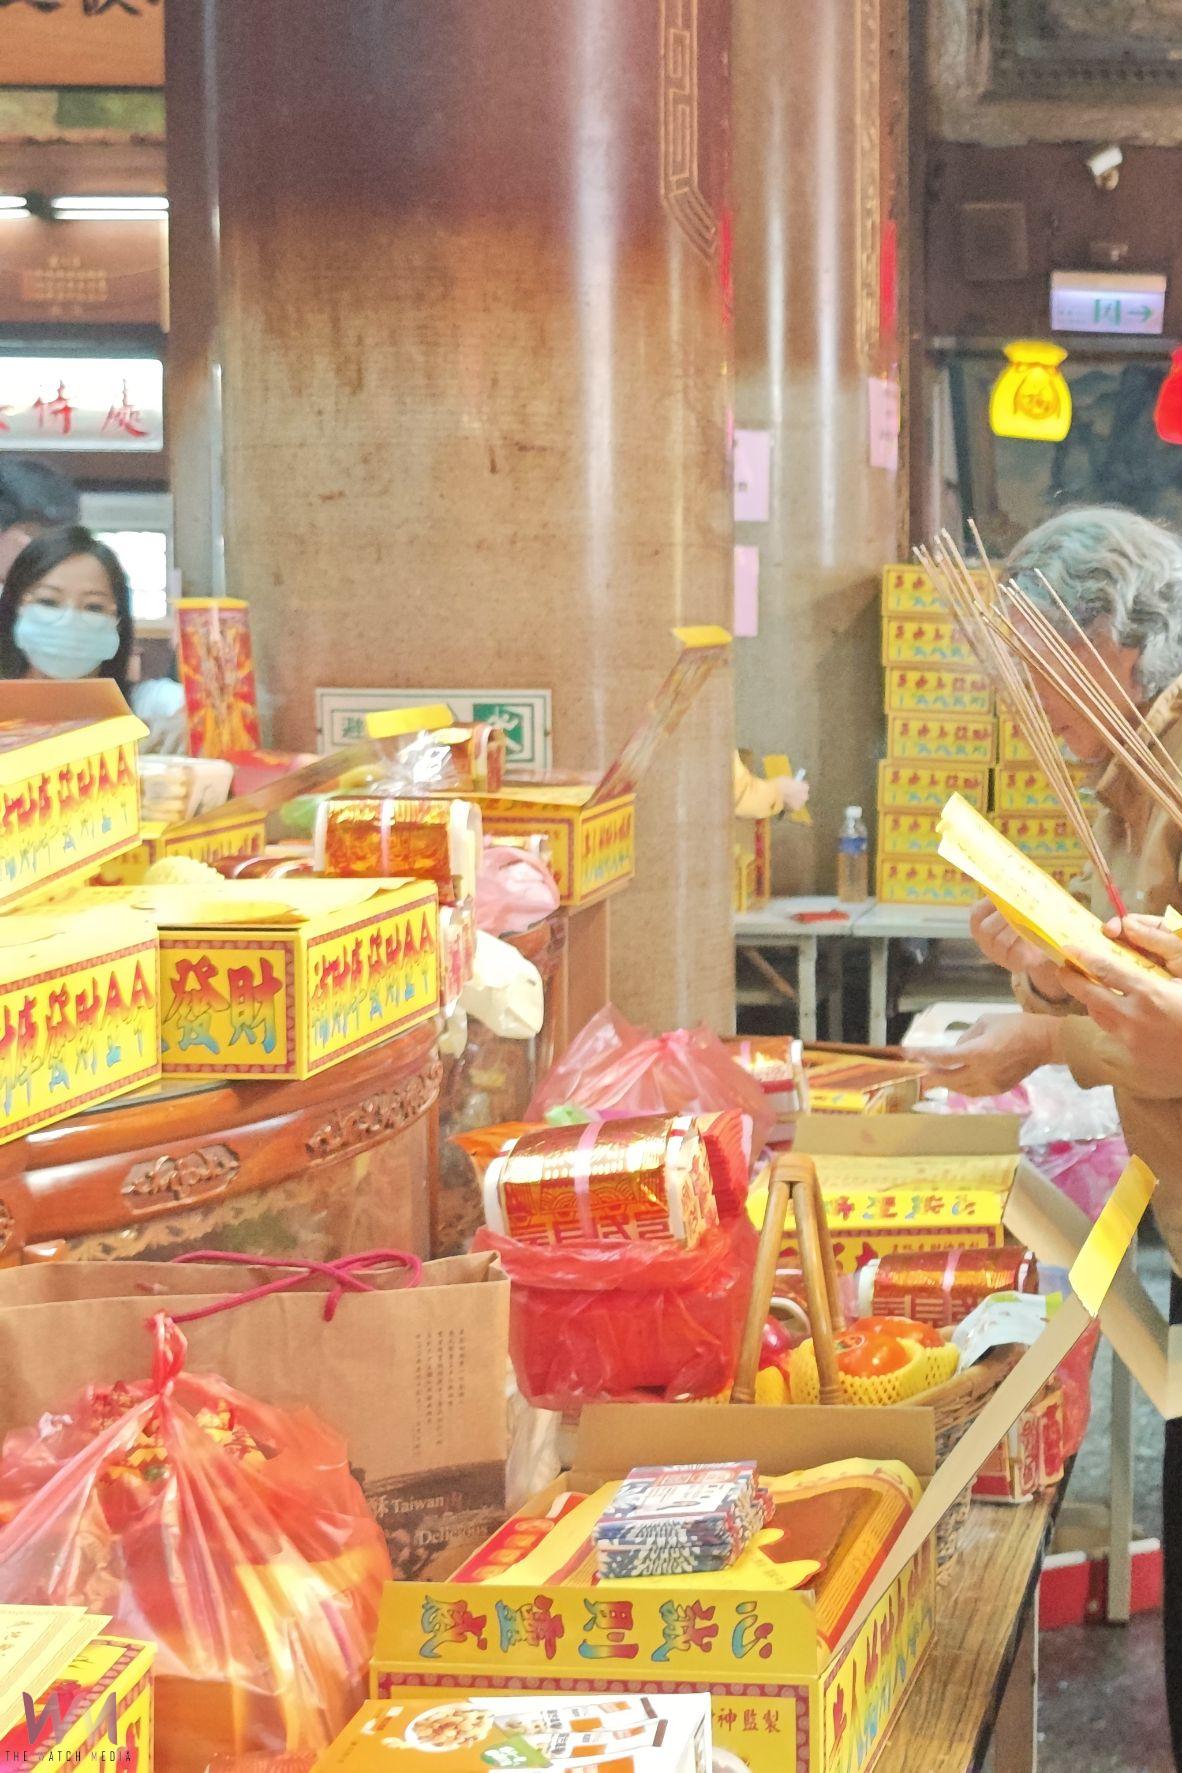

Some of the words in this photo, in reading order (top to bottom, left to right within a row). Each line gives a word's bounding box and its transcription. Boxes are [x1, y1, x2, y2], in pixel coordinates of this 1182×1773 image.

[161, 955, 284, 1054] 發財
[391, 1496, 445, 1514] Taiwan
[420, 1594, 774, 1661] 心誠則靈感
[712, 1708, 781, 1734] 神監製
